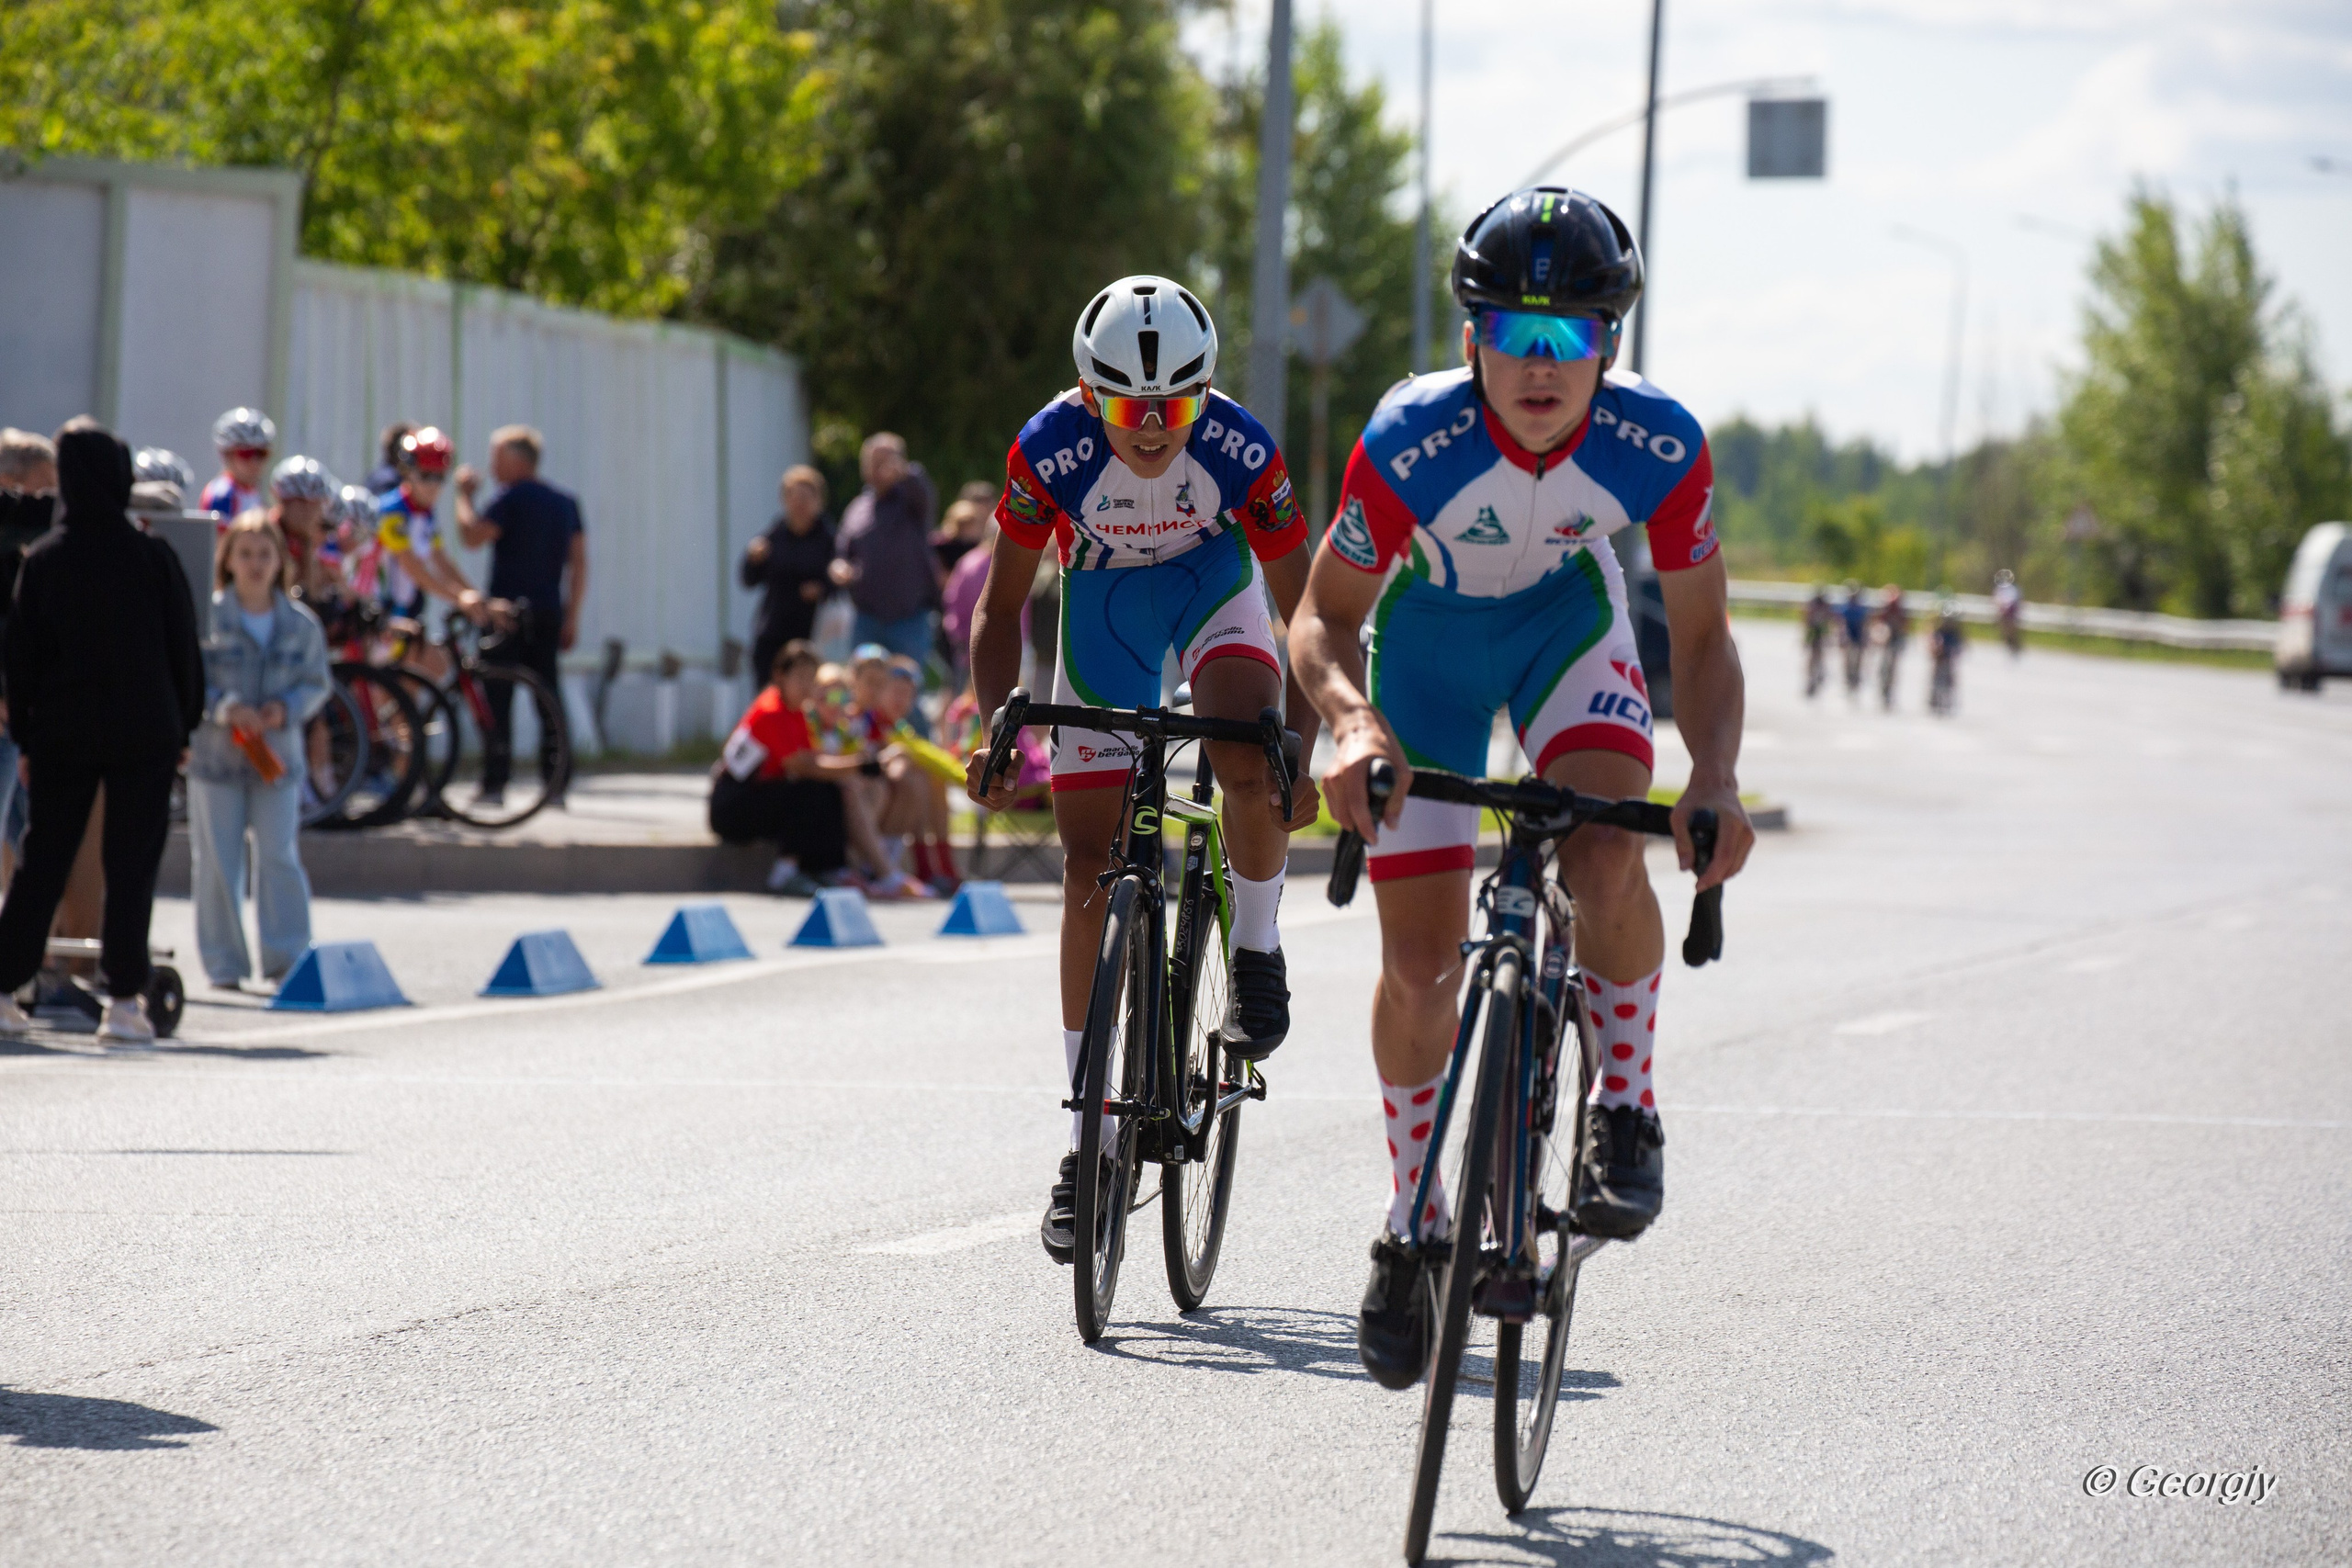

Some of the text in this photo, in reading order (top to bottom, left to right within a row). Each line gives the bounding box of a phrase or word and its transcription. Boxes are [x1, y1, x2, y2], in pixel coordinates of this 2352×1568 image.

[1035, 436, 1094, 484] PRO
[1202, 418, 1267, 470] PRO
[1389, 406, 1476, 481] PRO
[1593, 406, 1687, 464] PRO
